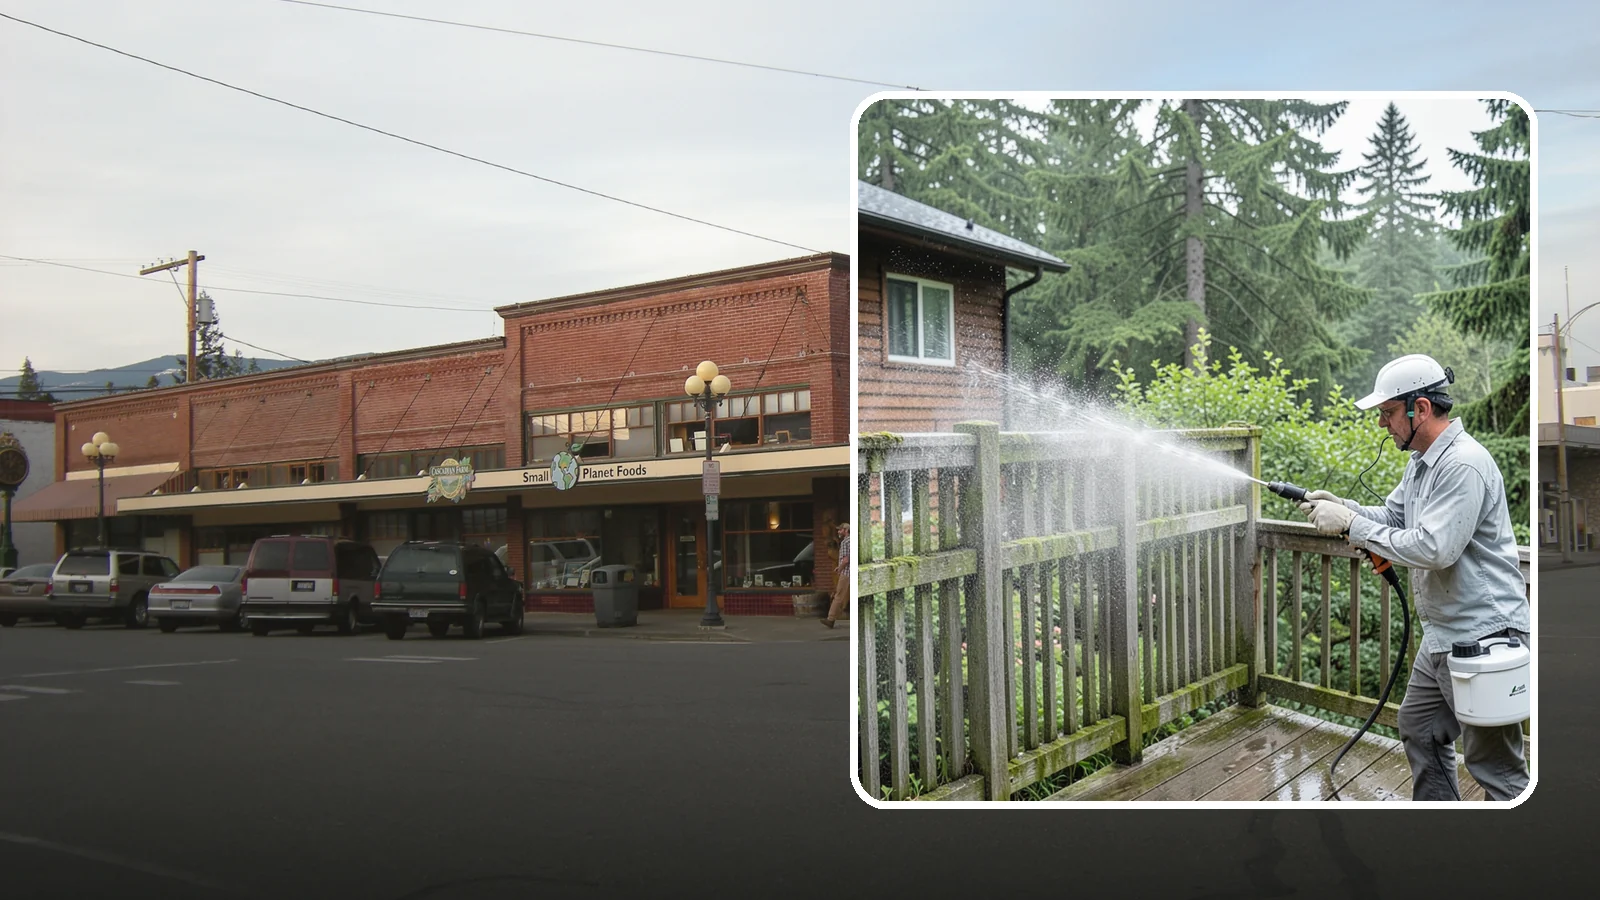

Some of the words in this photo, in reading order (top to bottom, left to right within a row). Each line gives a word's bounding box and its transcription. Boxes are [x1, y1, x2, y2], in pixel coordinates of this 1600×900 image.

[431, 466, 455, 475] CASCADIAN
[456, 466, 469, 474] FARM
[523, 471, 549, 483] Small
[583, 468, 614, 479] Planet
[617, 464, 647, 477] Foods
